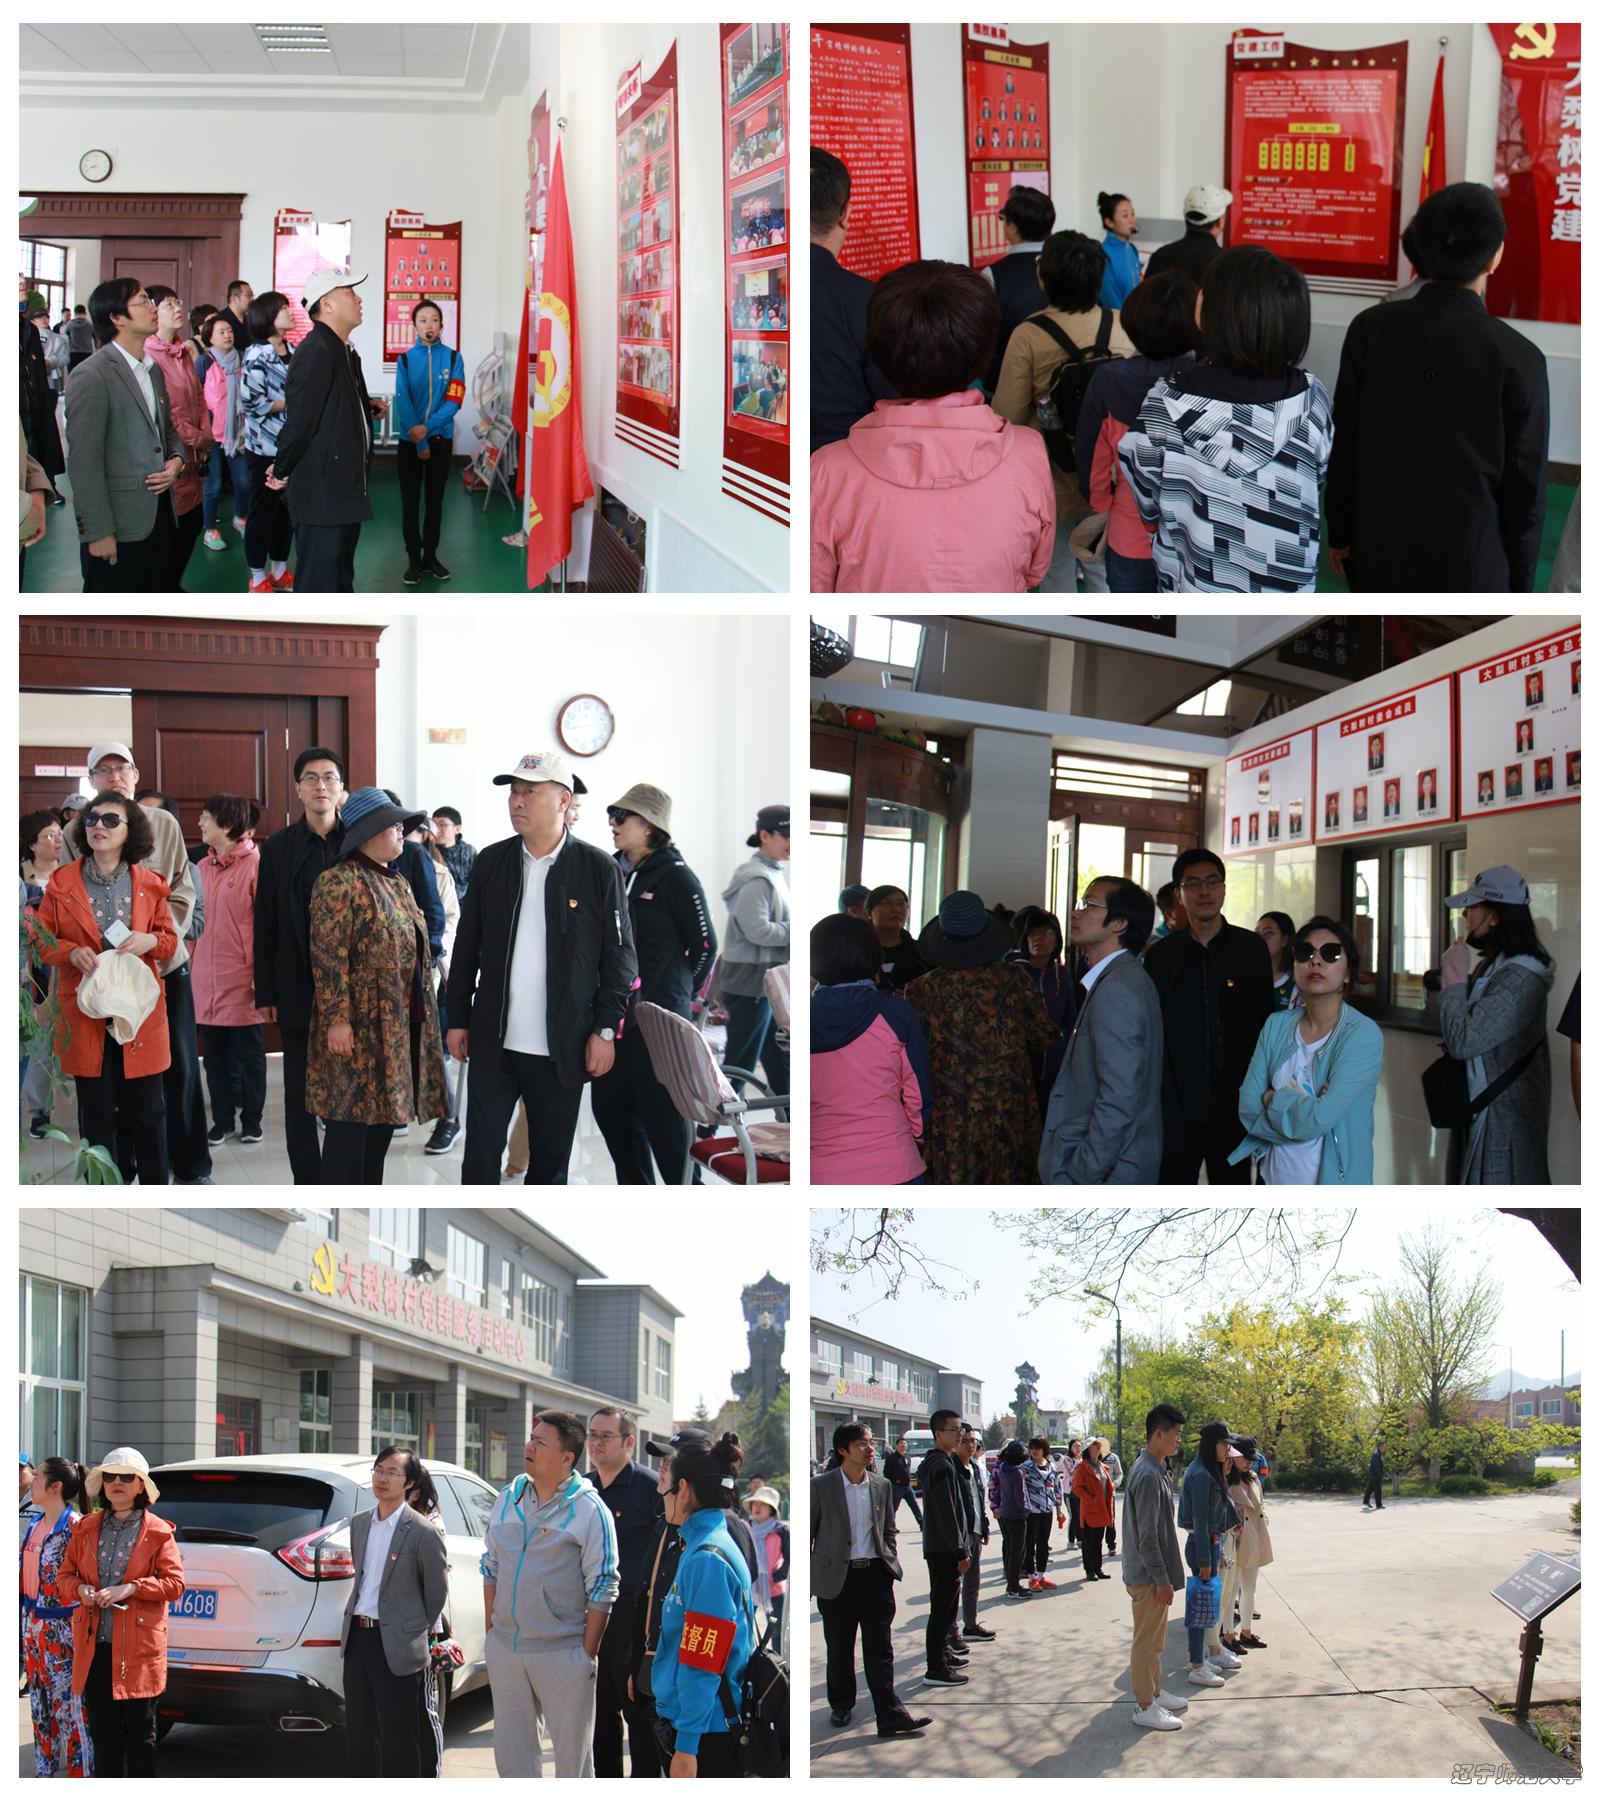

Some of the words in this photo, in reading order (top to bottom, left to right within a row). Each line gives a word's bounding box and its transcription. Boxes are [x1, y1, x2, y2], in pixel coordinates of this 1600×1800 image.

[1236, 41, 1280, 54] 党建工作
[1483, 635, 1581, 681] 大梨树村实业总
[692, 893, 709, 937] SOUTHERN
[168, 1594, 215, 1615] W608
